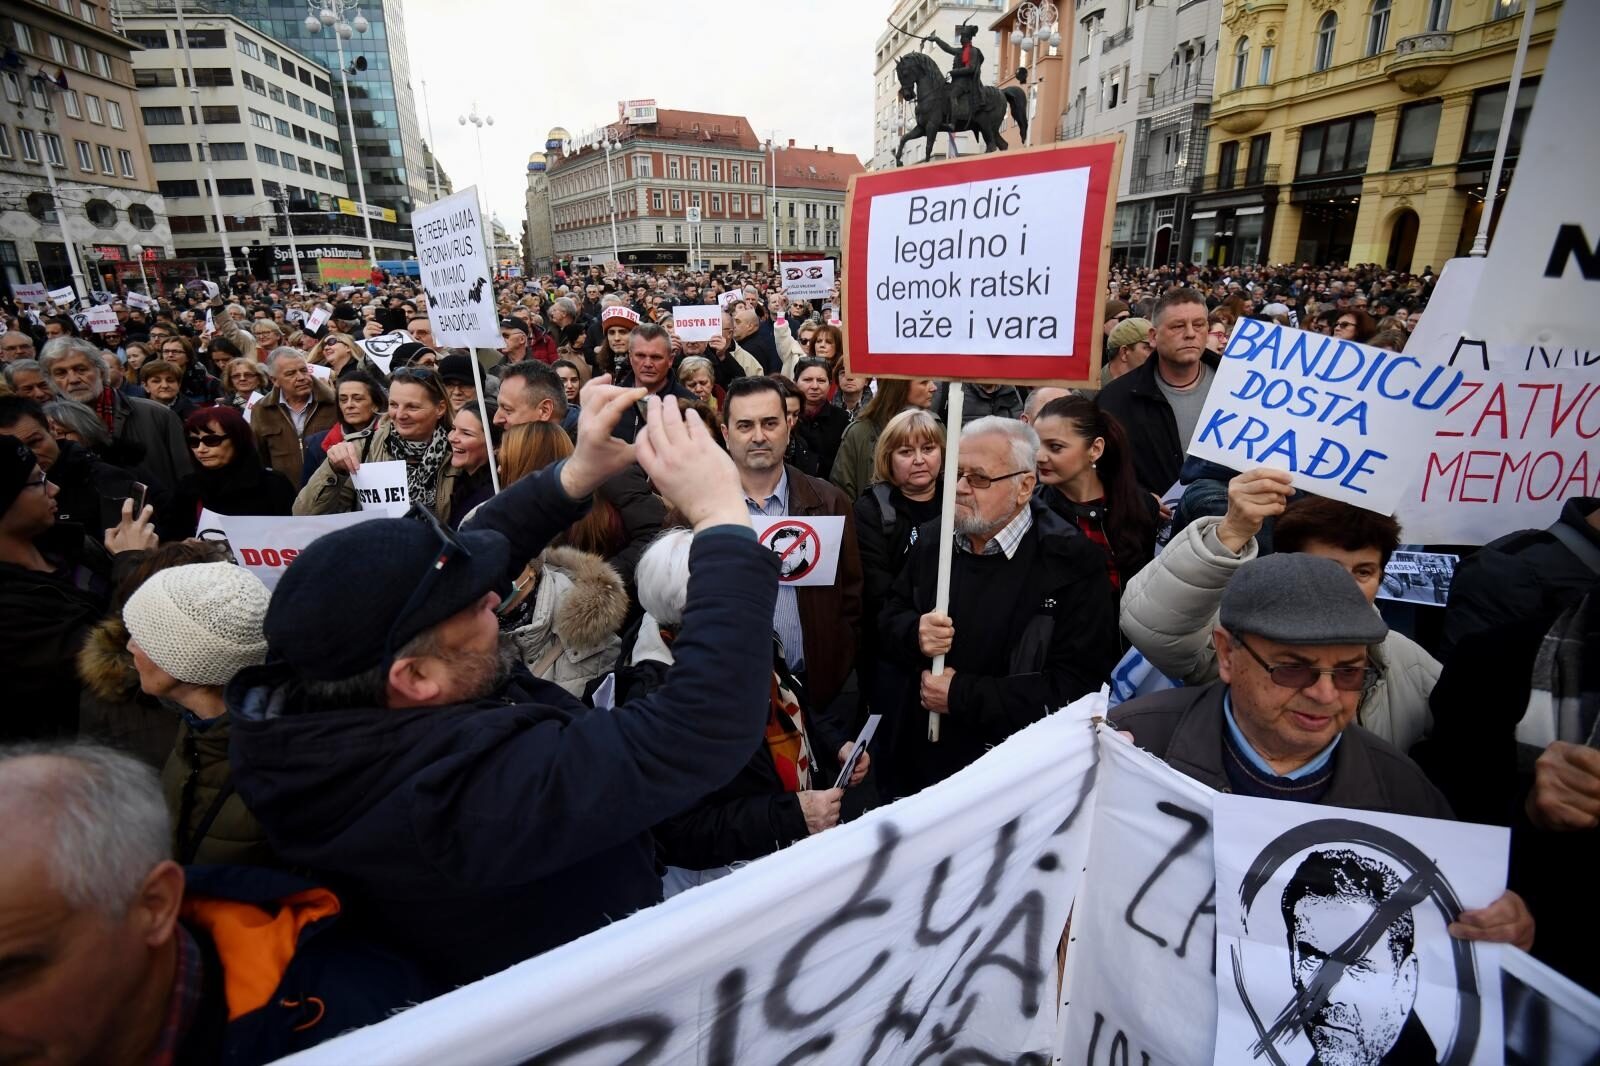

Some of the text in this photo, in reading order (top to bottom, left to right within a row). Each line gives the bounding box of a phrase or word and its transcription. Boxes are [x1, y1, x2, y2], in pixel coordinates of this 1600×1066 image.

[908, 185, 1021, 225] Bandić
[423, 218, 449, 240] TREBA
[449, 208, 476, 234] NAMA
[274, 246, 305, 261] Špia
[894, 224, 1028, 269] legalno i
[439, 264, 466, 286] IMAMO
[438, 290, 468, 310] MILANA
[676, 318, 720, 328] DOSTA JE!
[895, 309, 1058, 339] laže i vara
[1230, 370, 1368, 436] DOSTA
[1198, 408, 1389, 494] KRAĐE
[356, 487, 405, 503] STA JE!
[240, 549, 303, 566] DOS
